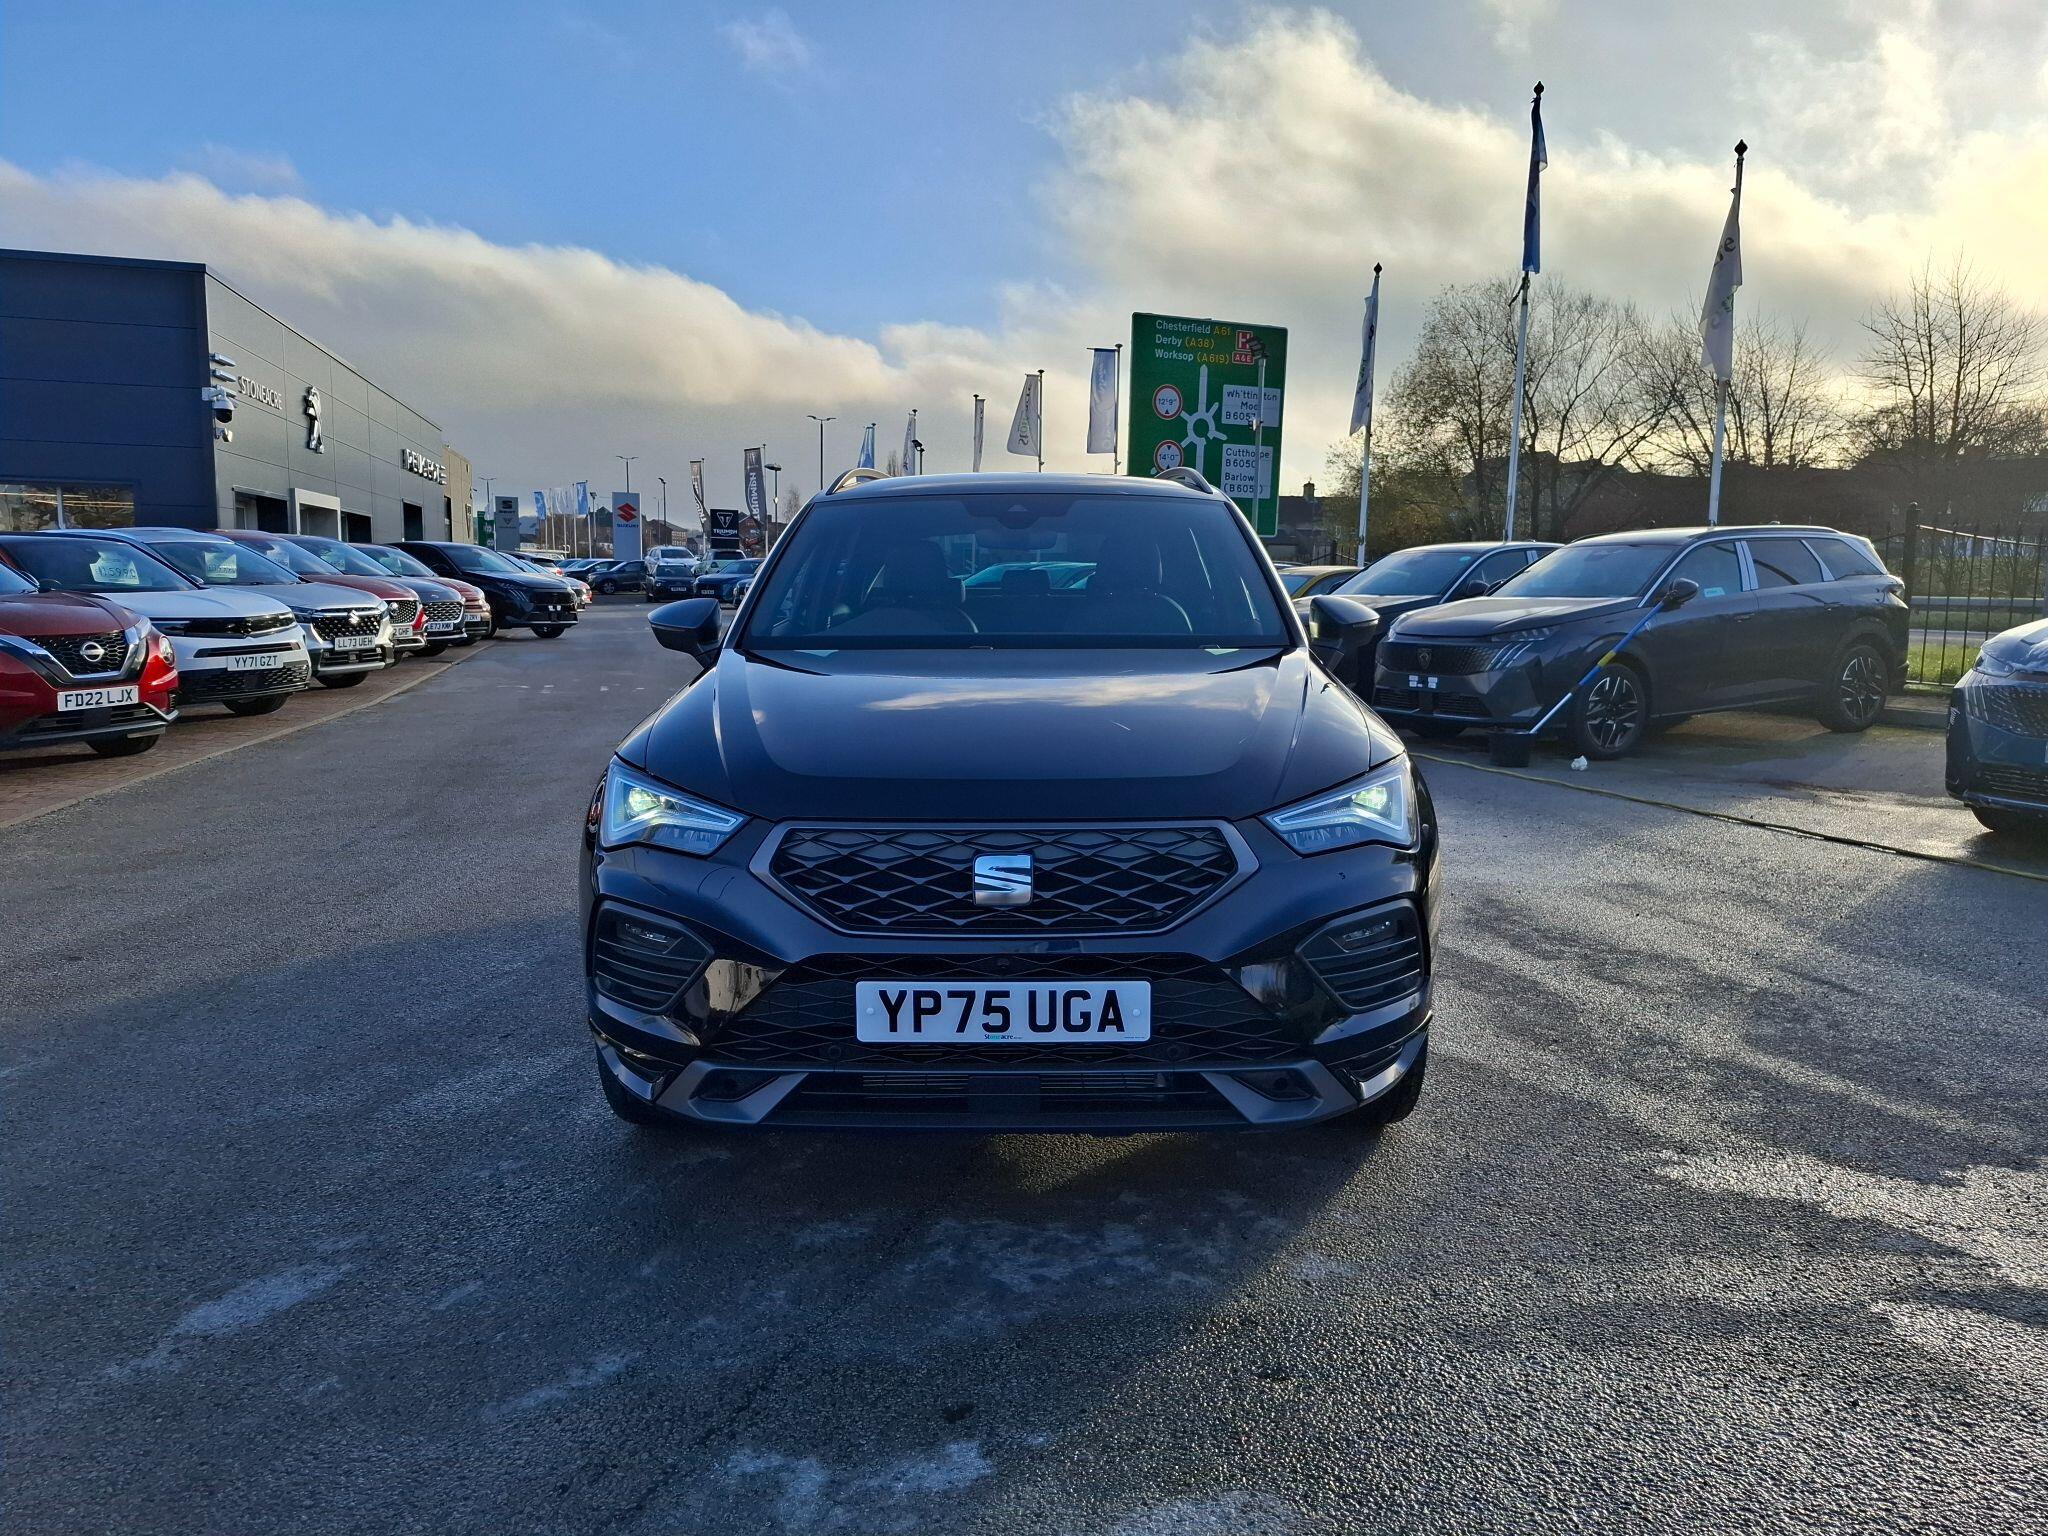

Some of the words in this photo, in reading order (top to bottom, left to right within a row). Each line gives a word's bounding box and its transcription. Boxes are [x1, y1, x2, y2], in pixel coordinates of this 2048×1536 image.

[1155, 320, 1211, 334] Chesterfield
[1213, 326, 1231, 336] A61
[1155, 334, 1182, 347] Derby
[1185, 336, 1215, 349] (A38)
[1155, 348, 1194, 362] Worksop
[1196, 352, 1229, 364] (A619)
[1234, 353, 1252, 363] A&E
[240, 375, 283, 410] STONEACRE
[1226, 389, 1277, 401] Whttinton
[1225, 447, 1270, 460] Cutthope
[1224, 472, 1255, 482] Barlow
[1223, 483, 1263, 495] (B605)
[337, 637, 357, 648] LL73
[234, 656, 260, 669] YY71
[260, 655, 278, 667] GZT
[64, 691, 104, 708] FD22
[106, 688, 134, 704] LJX
[878, 989, 1011, 1033] YP75
[1028, 989, 1125, 1033] UGA
